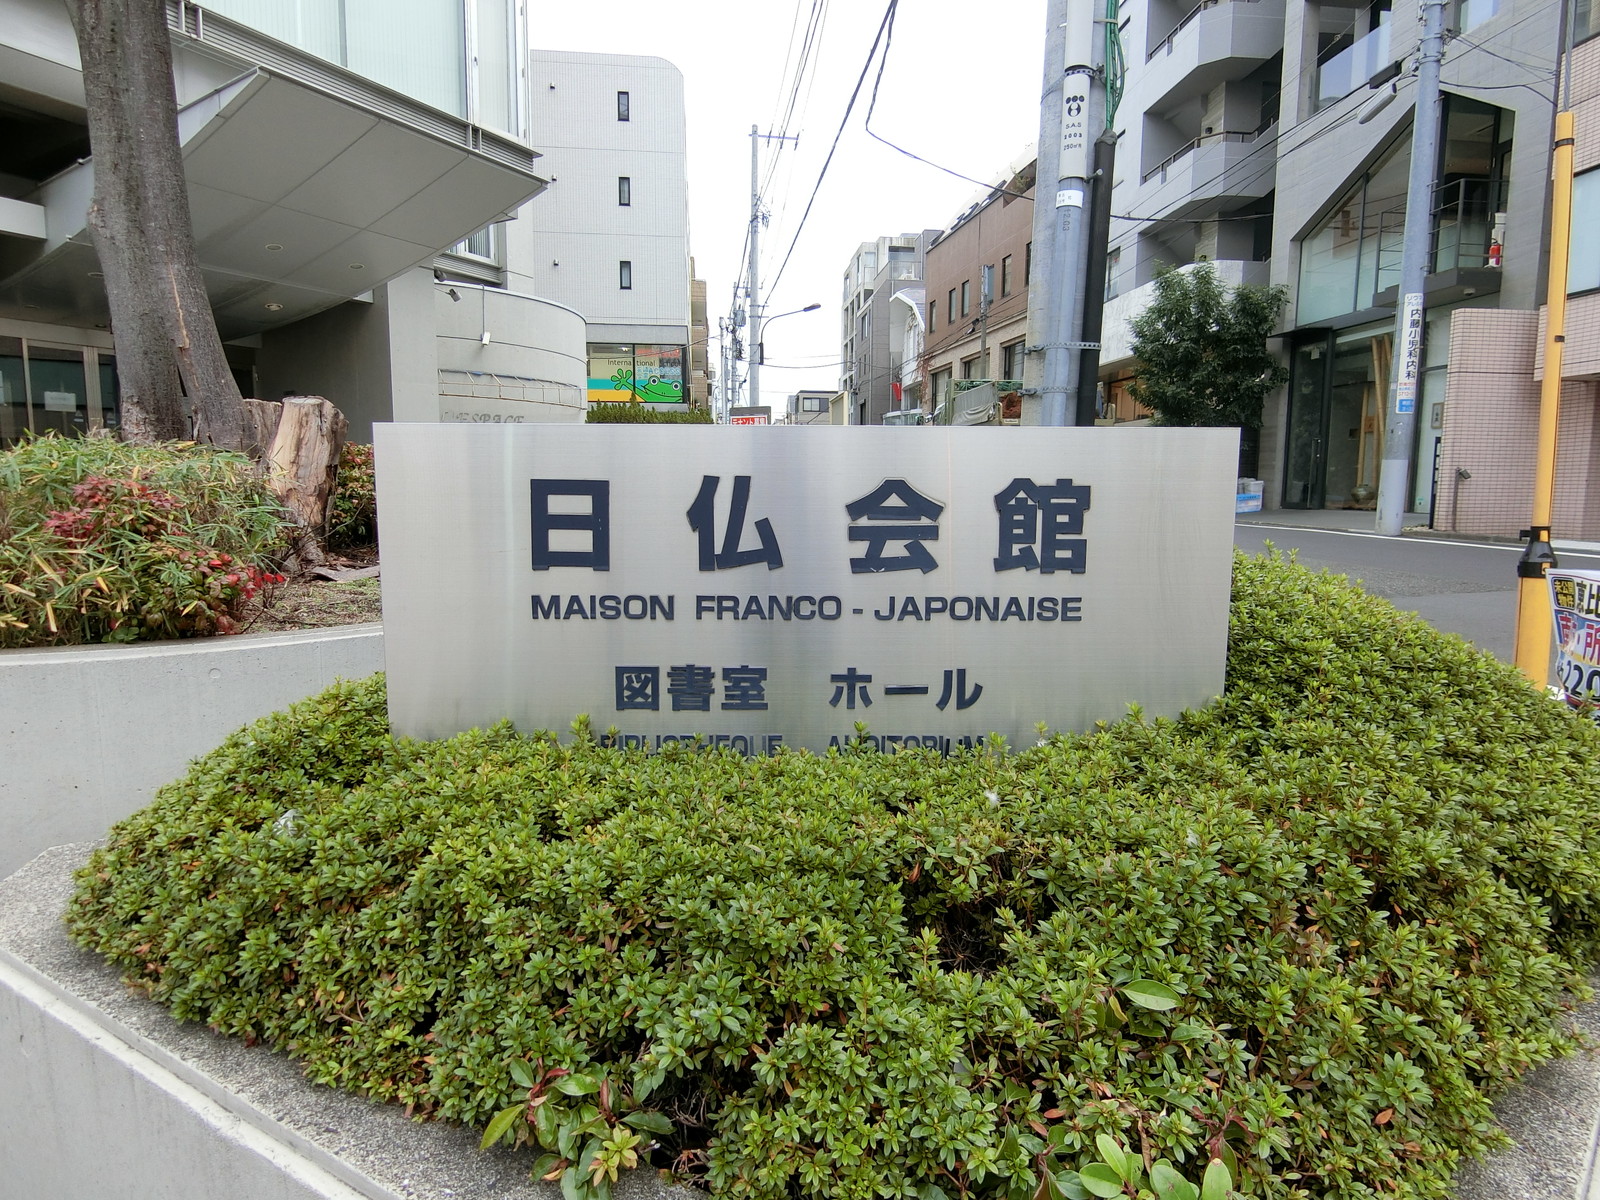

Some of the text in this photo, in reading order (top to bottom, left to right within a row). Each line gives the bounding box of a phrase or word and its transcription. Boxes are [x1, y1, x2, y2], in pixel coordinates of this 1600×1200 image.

[530, 475, 1091, 574] 日仏会館
[531, 594, 675, 621] MAISON
[615, 664, 983, 712] 図書室 ホール
